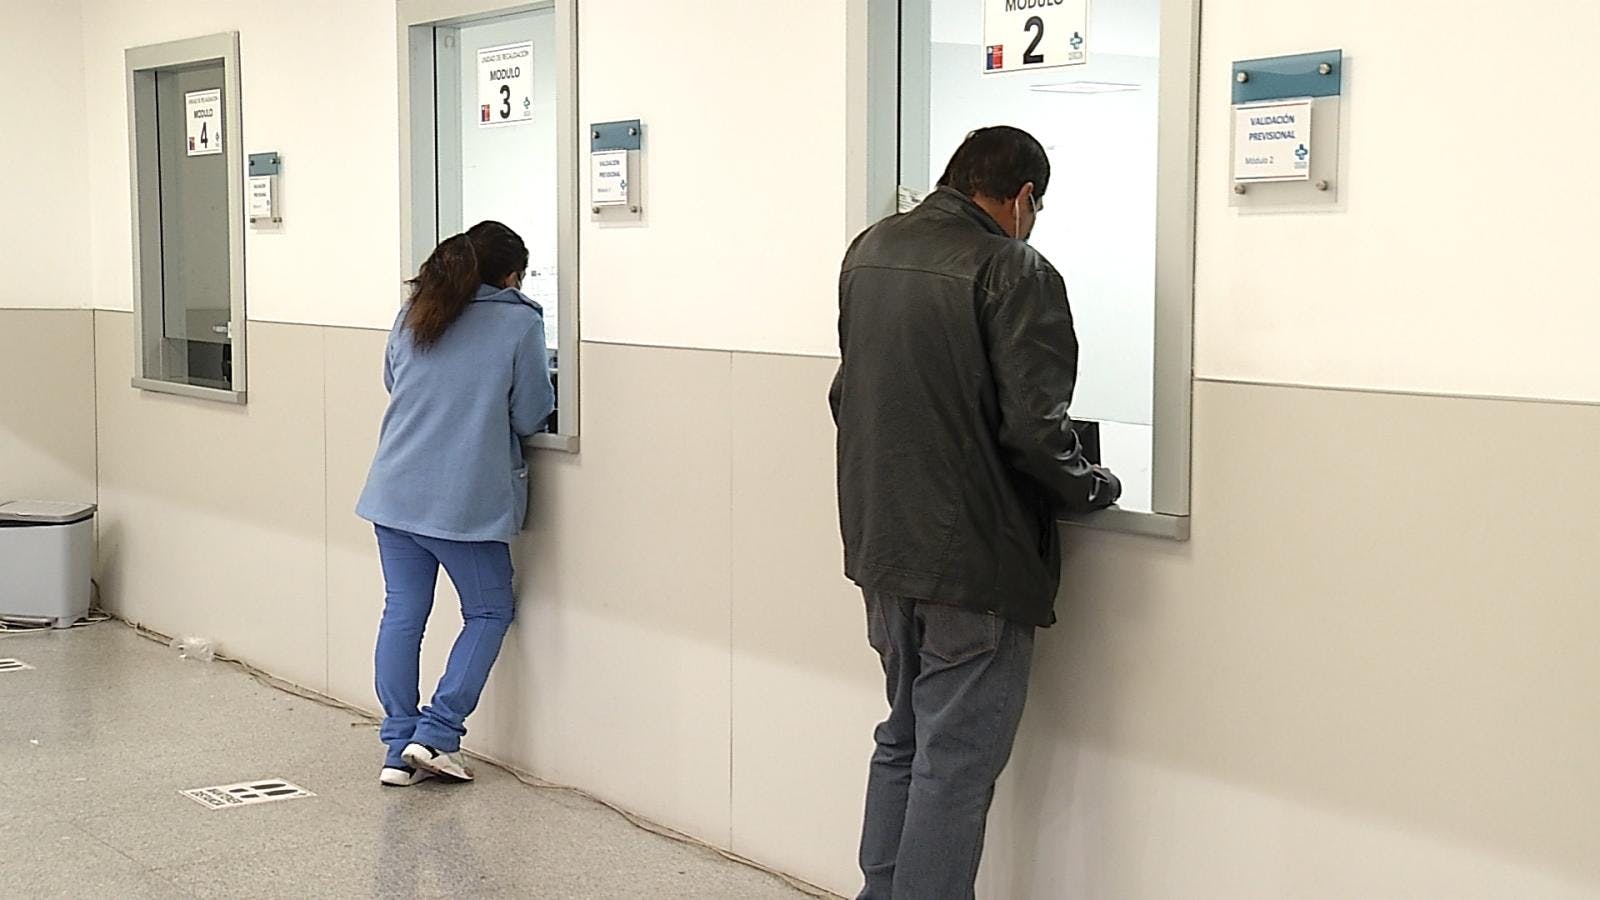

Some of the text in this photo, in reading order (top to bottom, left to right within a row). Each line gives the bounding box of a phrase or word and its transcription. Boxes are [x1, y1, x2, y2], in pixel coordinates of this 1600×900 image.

[1022, 16, 1045, 65] 2
[489, 66, 521, 81] MODULO
[499, 85, 511, 119] 3
[1250, 113, 1296, 126] VALIDACIÓN
[200, 121, 208, 149] 4
[1248, 130, 1297, 141] PREVISIONAL
